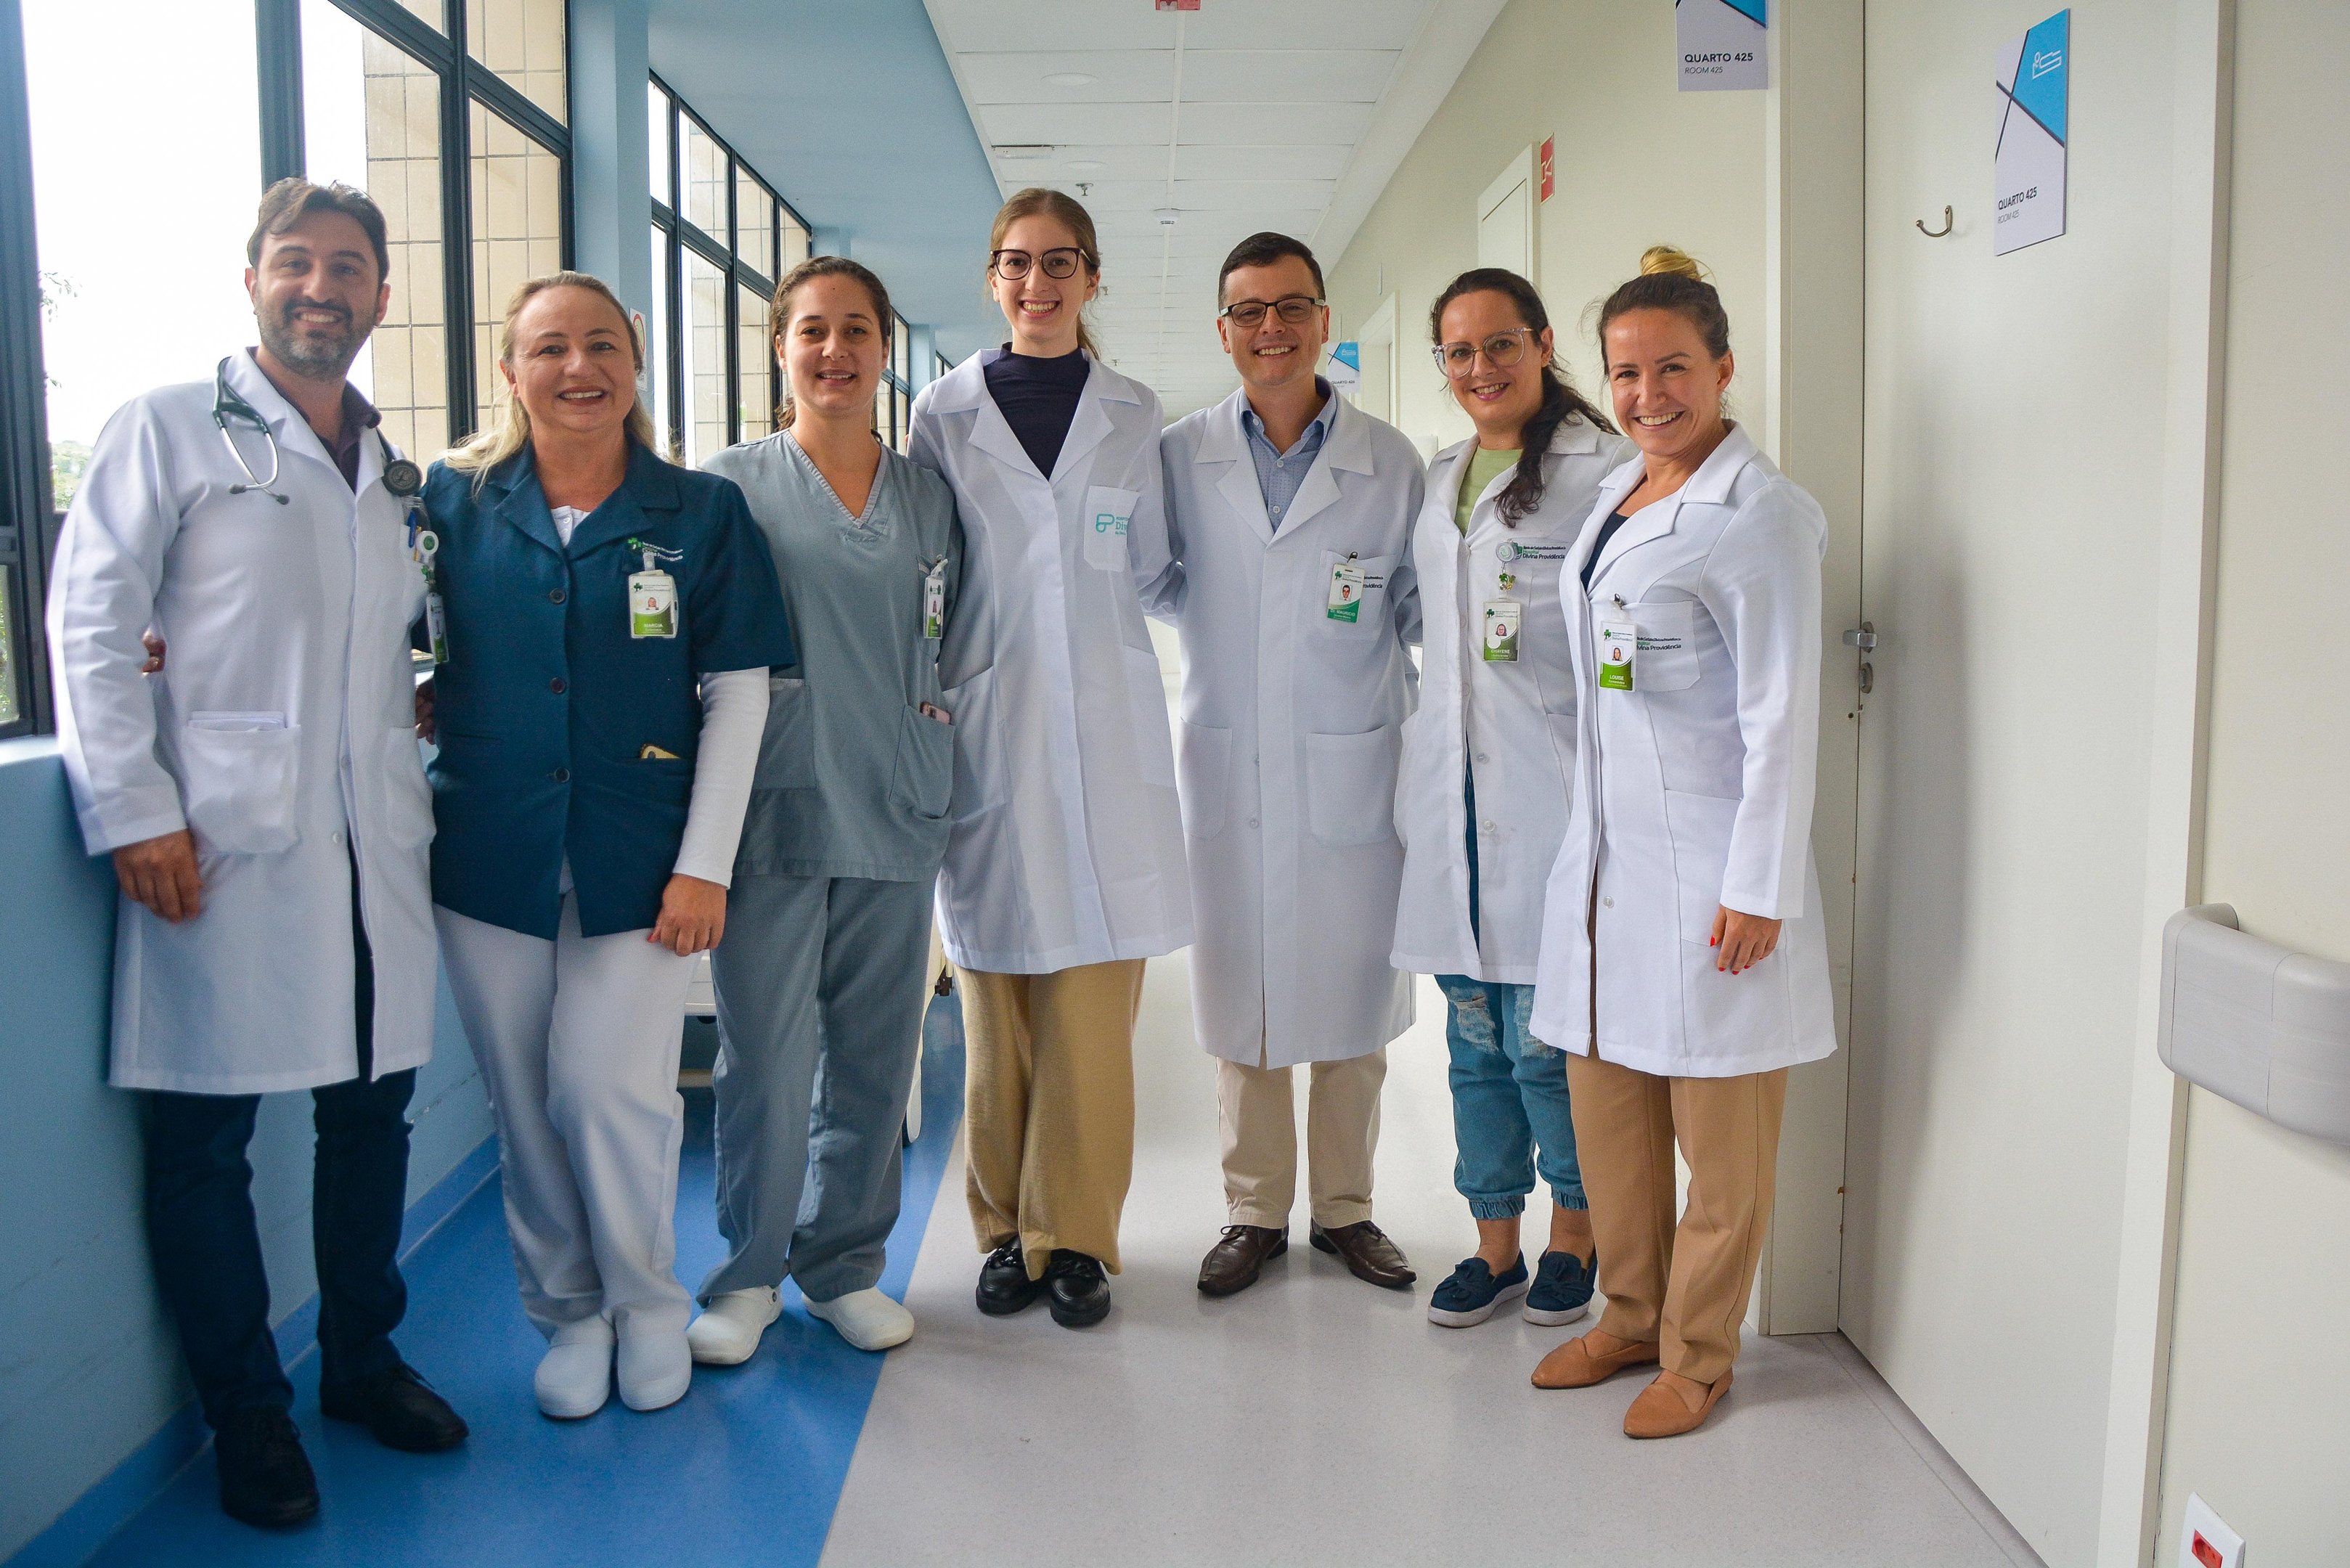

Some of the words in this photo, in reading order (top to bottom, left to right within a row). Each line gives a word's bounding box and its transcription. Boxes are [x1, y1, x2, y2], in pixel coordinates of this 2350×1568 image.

[1684, 53, 1731, 62] QUARTO
[1734, 52, 1753, 62] 425
[1998, 192, 2025, 210] QUARTO
[2025, 187, 2037, 200] 425
[1998, 212, 2012, 224] ROOM
